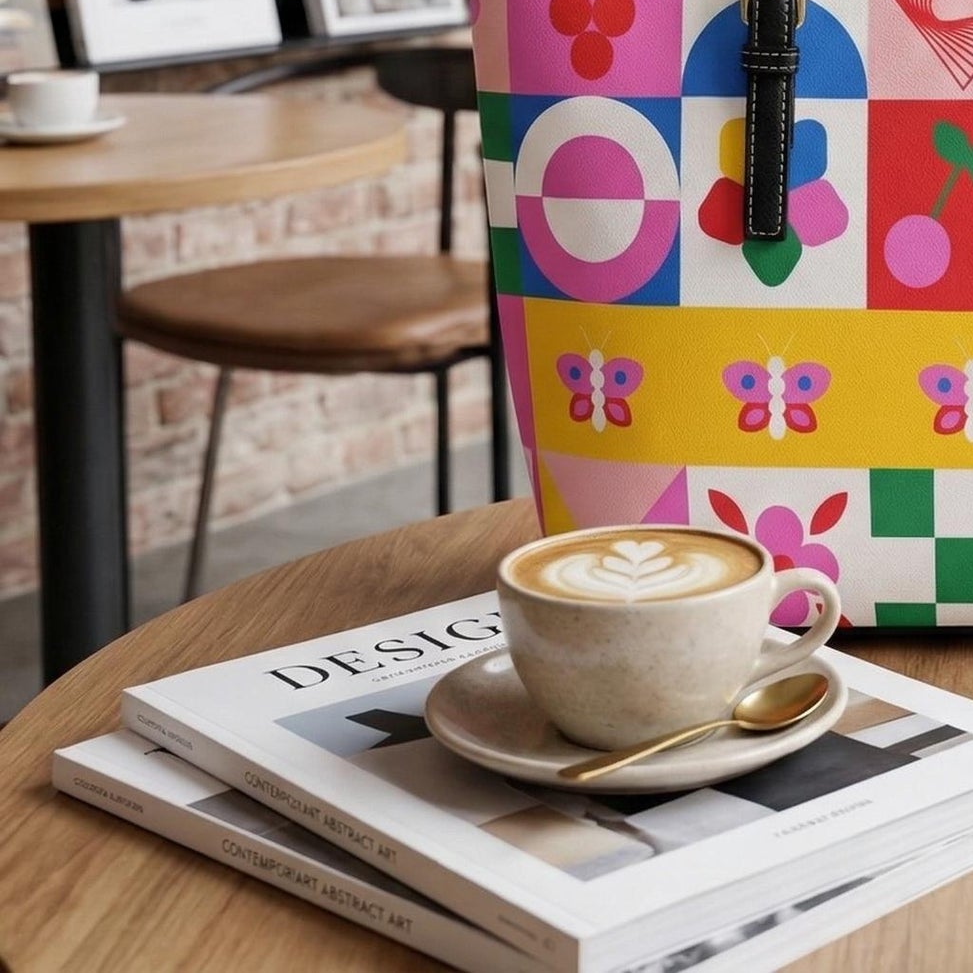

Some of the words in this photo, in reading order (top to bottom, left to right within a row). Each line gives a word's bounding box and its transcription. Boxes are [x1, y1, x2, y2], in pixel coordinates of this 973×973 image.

[264, 611, 502, 690] DESIG
[377, 844, 397, 864] ART
[320, 883, 385, 924] ABSTRACT
[387, 912, 414, 933] ART
